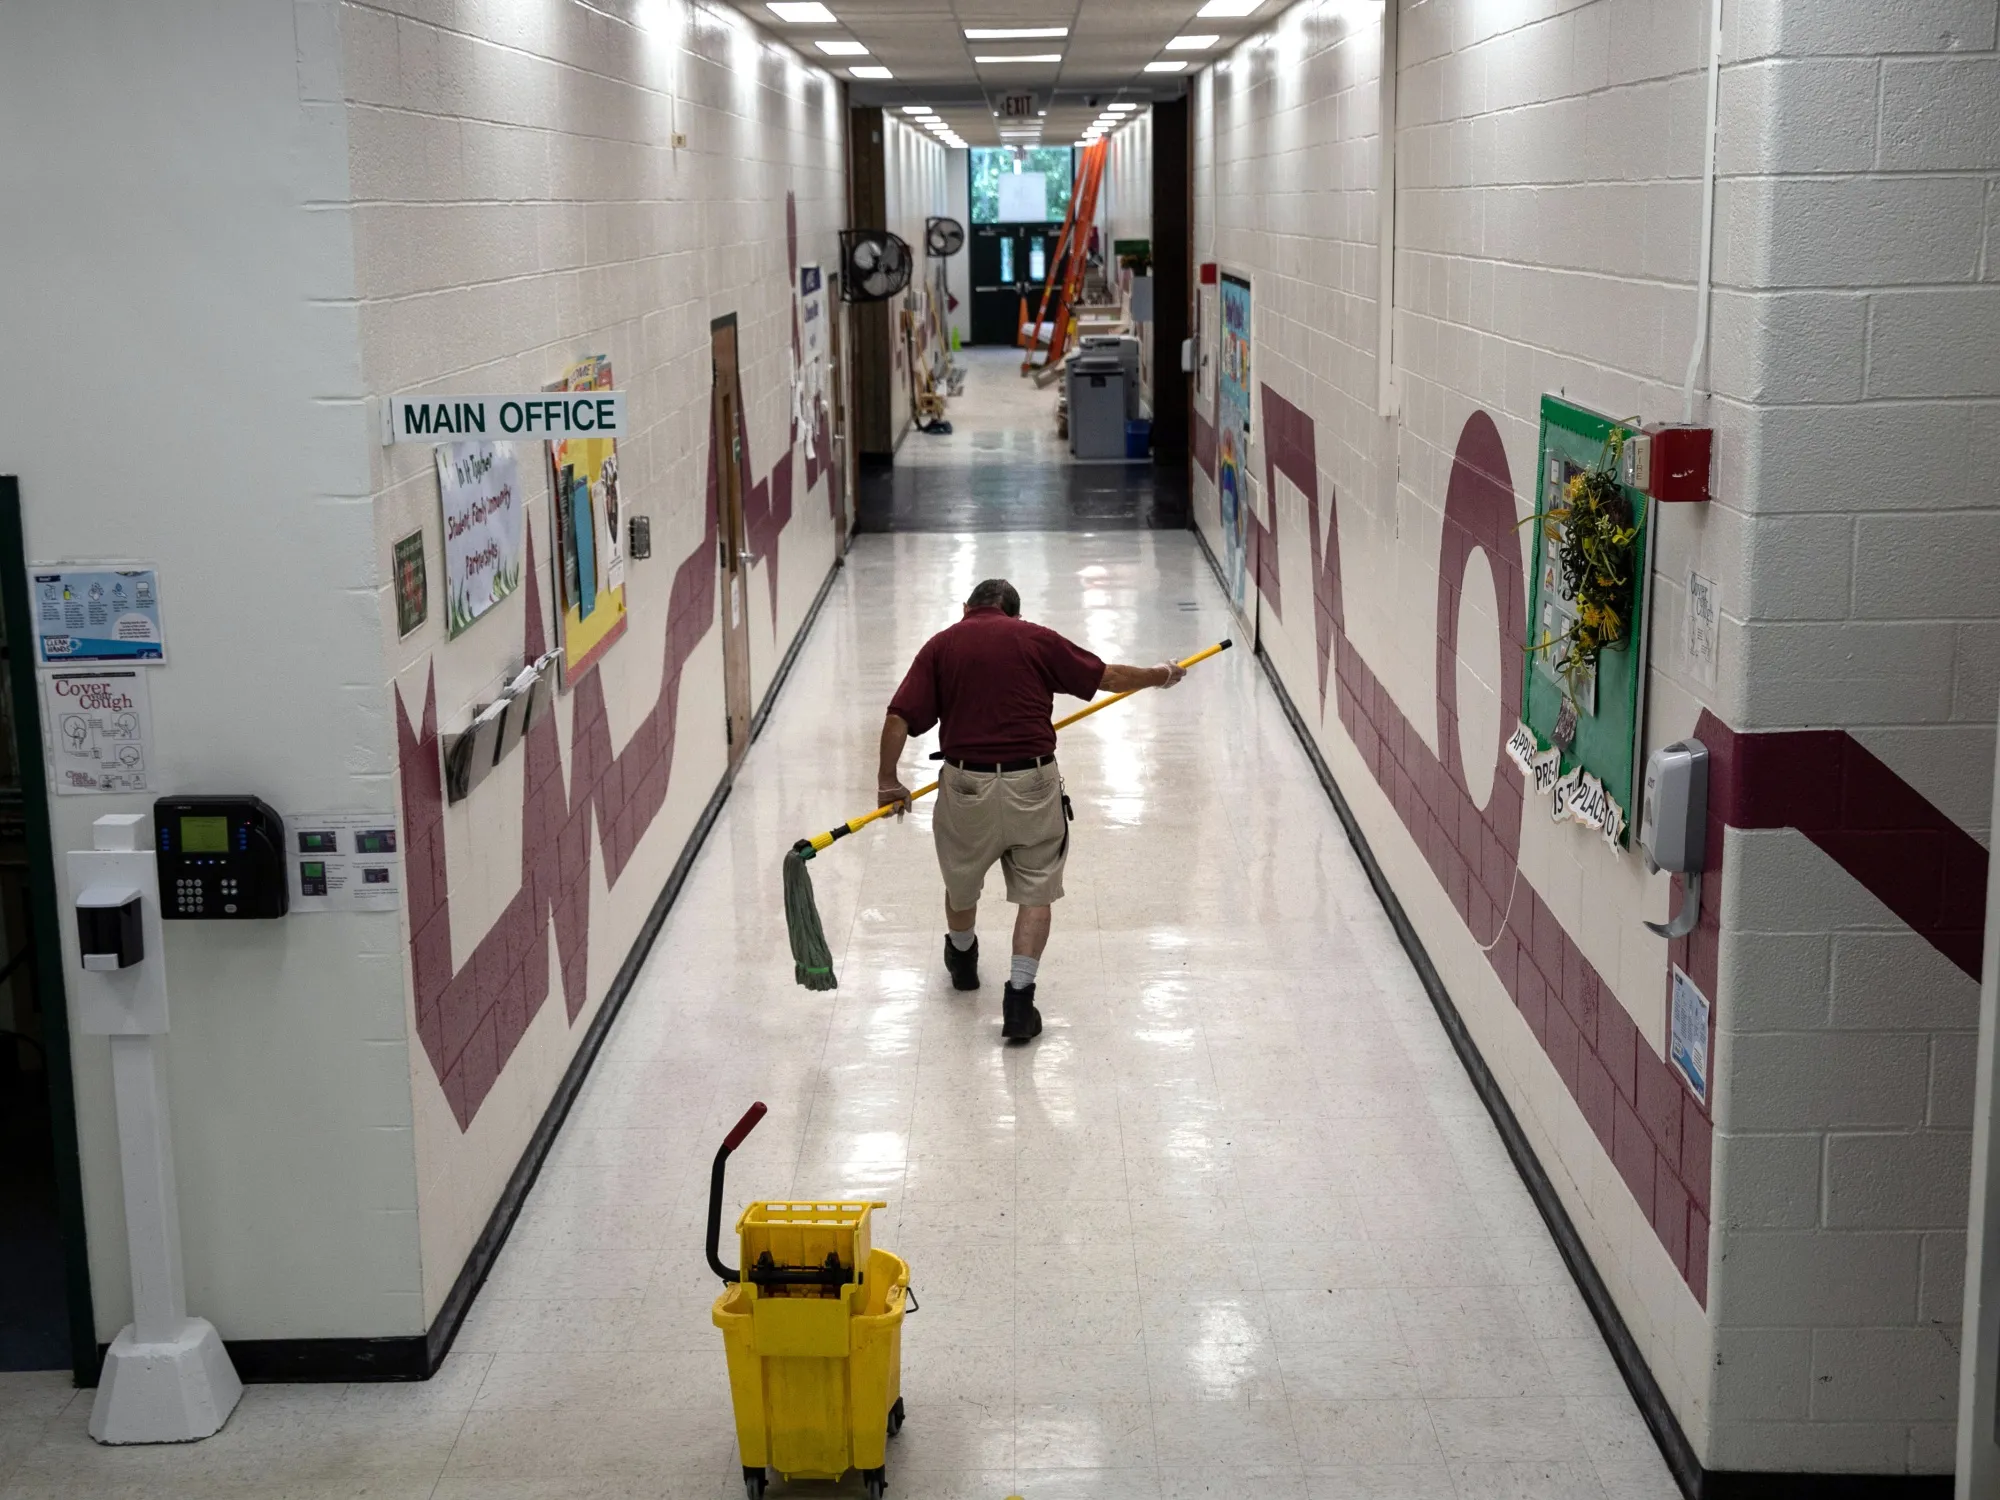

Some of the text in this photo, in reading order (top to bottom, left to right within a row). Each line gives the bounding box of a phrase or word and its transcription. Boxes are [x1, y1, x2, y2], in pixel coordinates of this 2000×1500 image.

[1006, 96, 1032, 116] EXIT
[404, 399, 616, 434] MAIN OFFICE
[56, 680, 110, 696] Cover
[80, 694, 133, 712] Cough
[1553, 786, 1563, 815] IS
